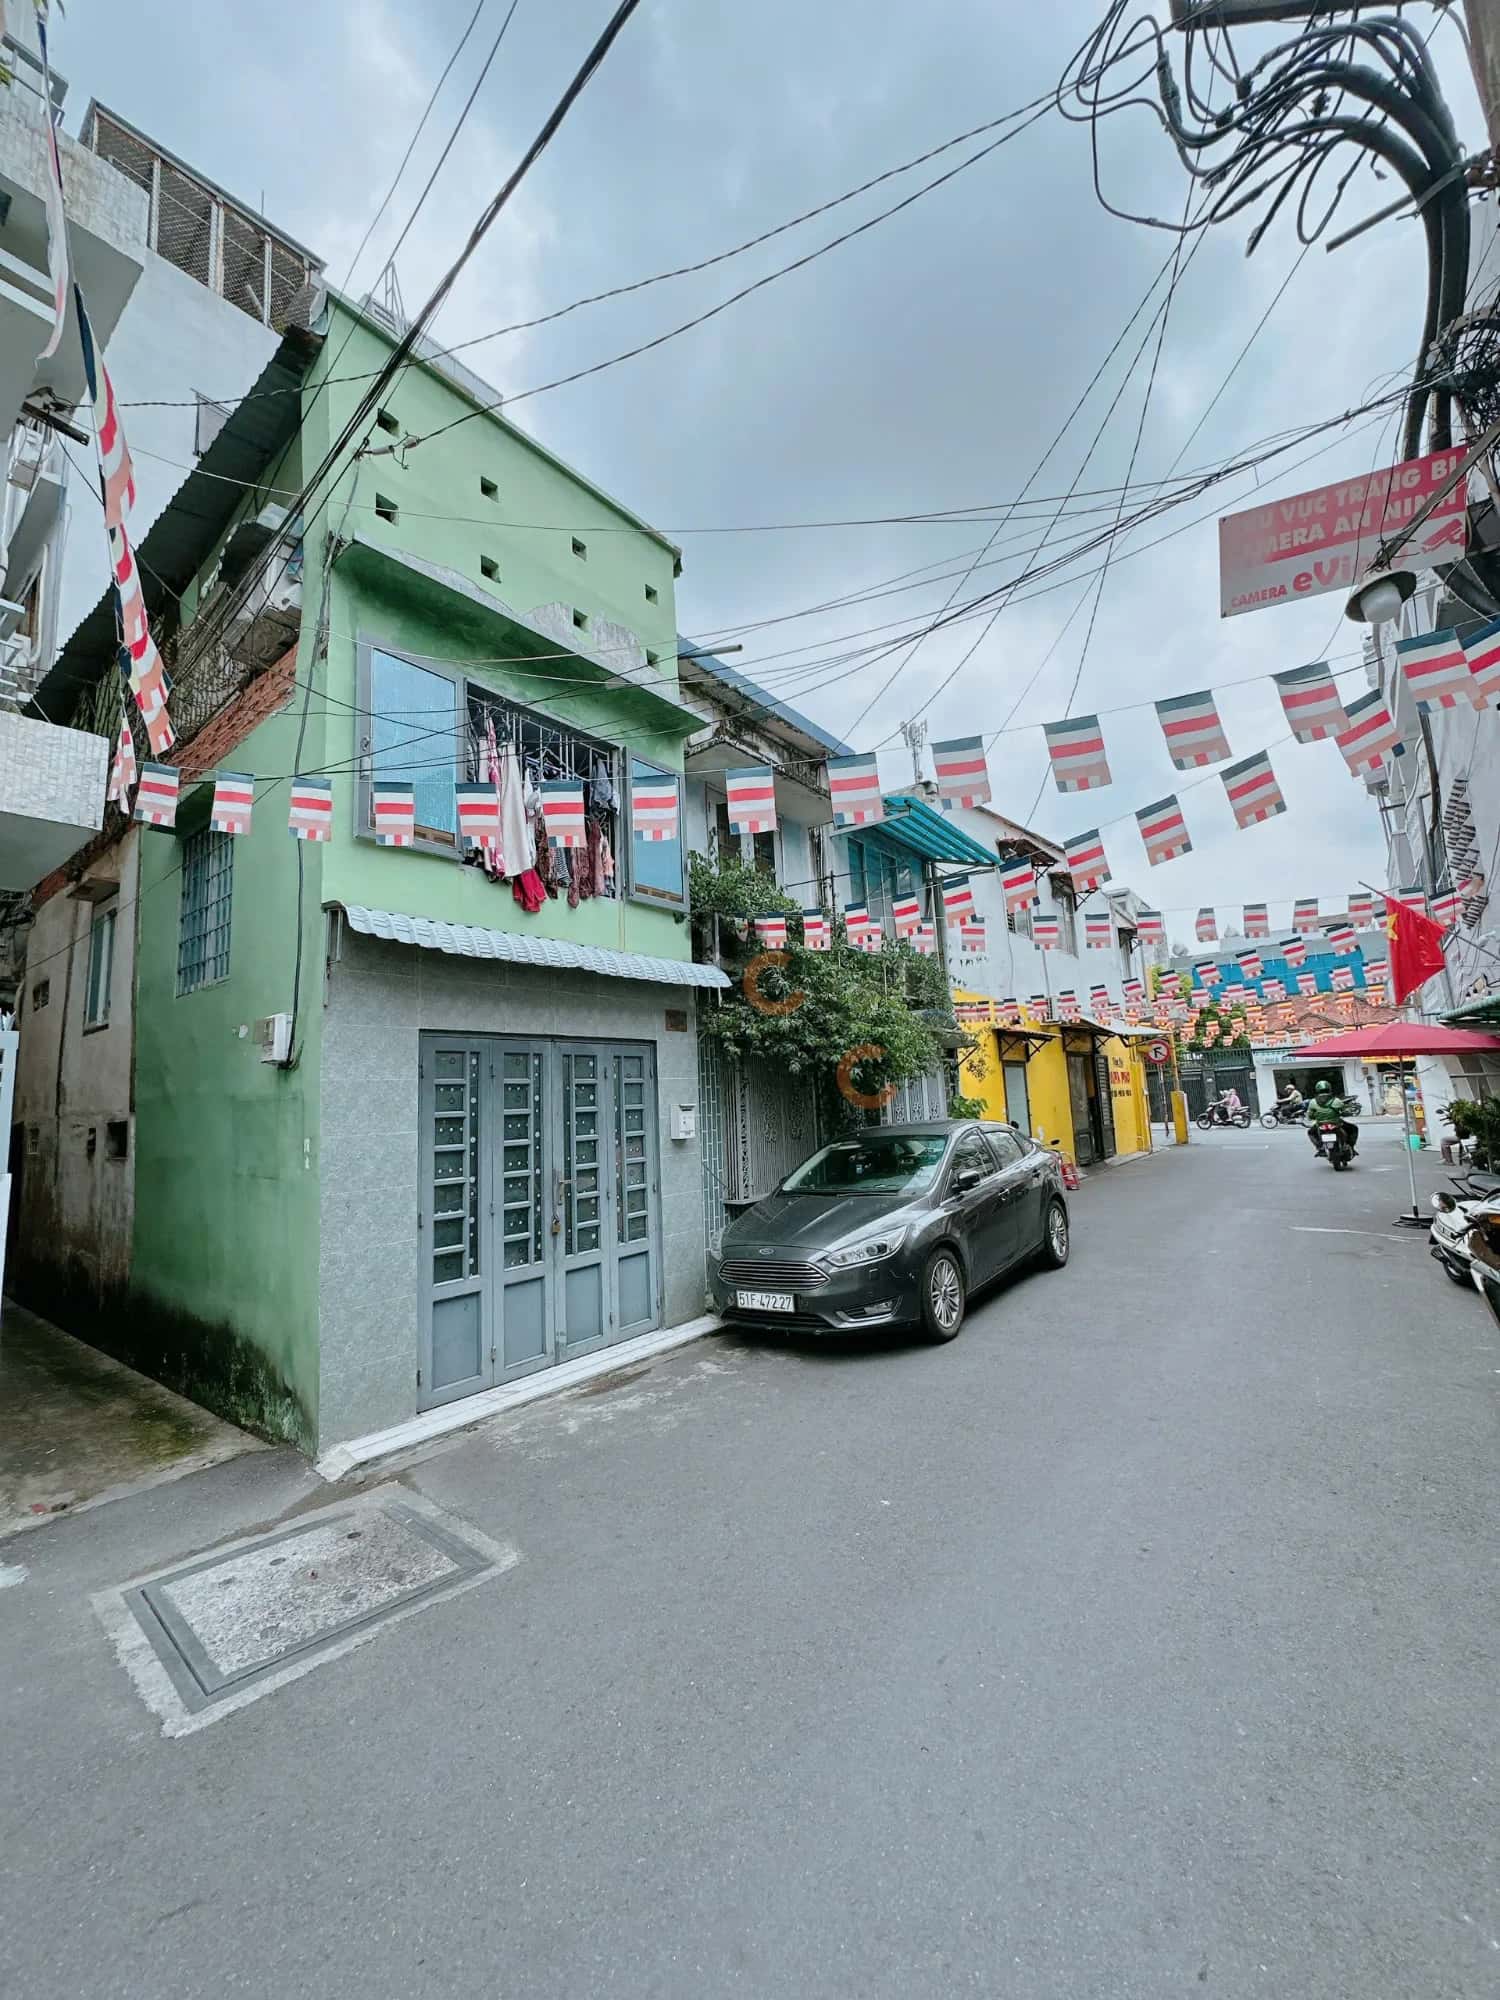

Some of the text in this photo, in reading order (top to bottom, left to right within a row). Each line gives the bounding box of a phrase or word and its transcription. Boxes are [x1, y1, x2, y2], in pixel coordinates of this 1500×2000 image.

[1335, 467, 1420, 508] TRANG
[1333, 509, 1372, 537] AN
[1231, 584, 1288, 608] CAMERA
